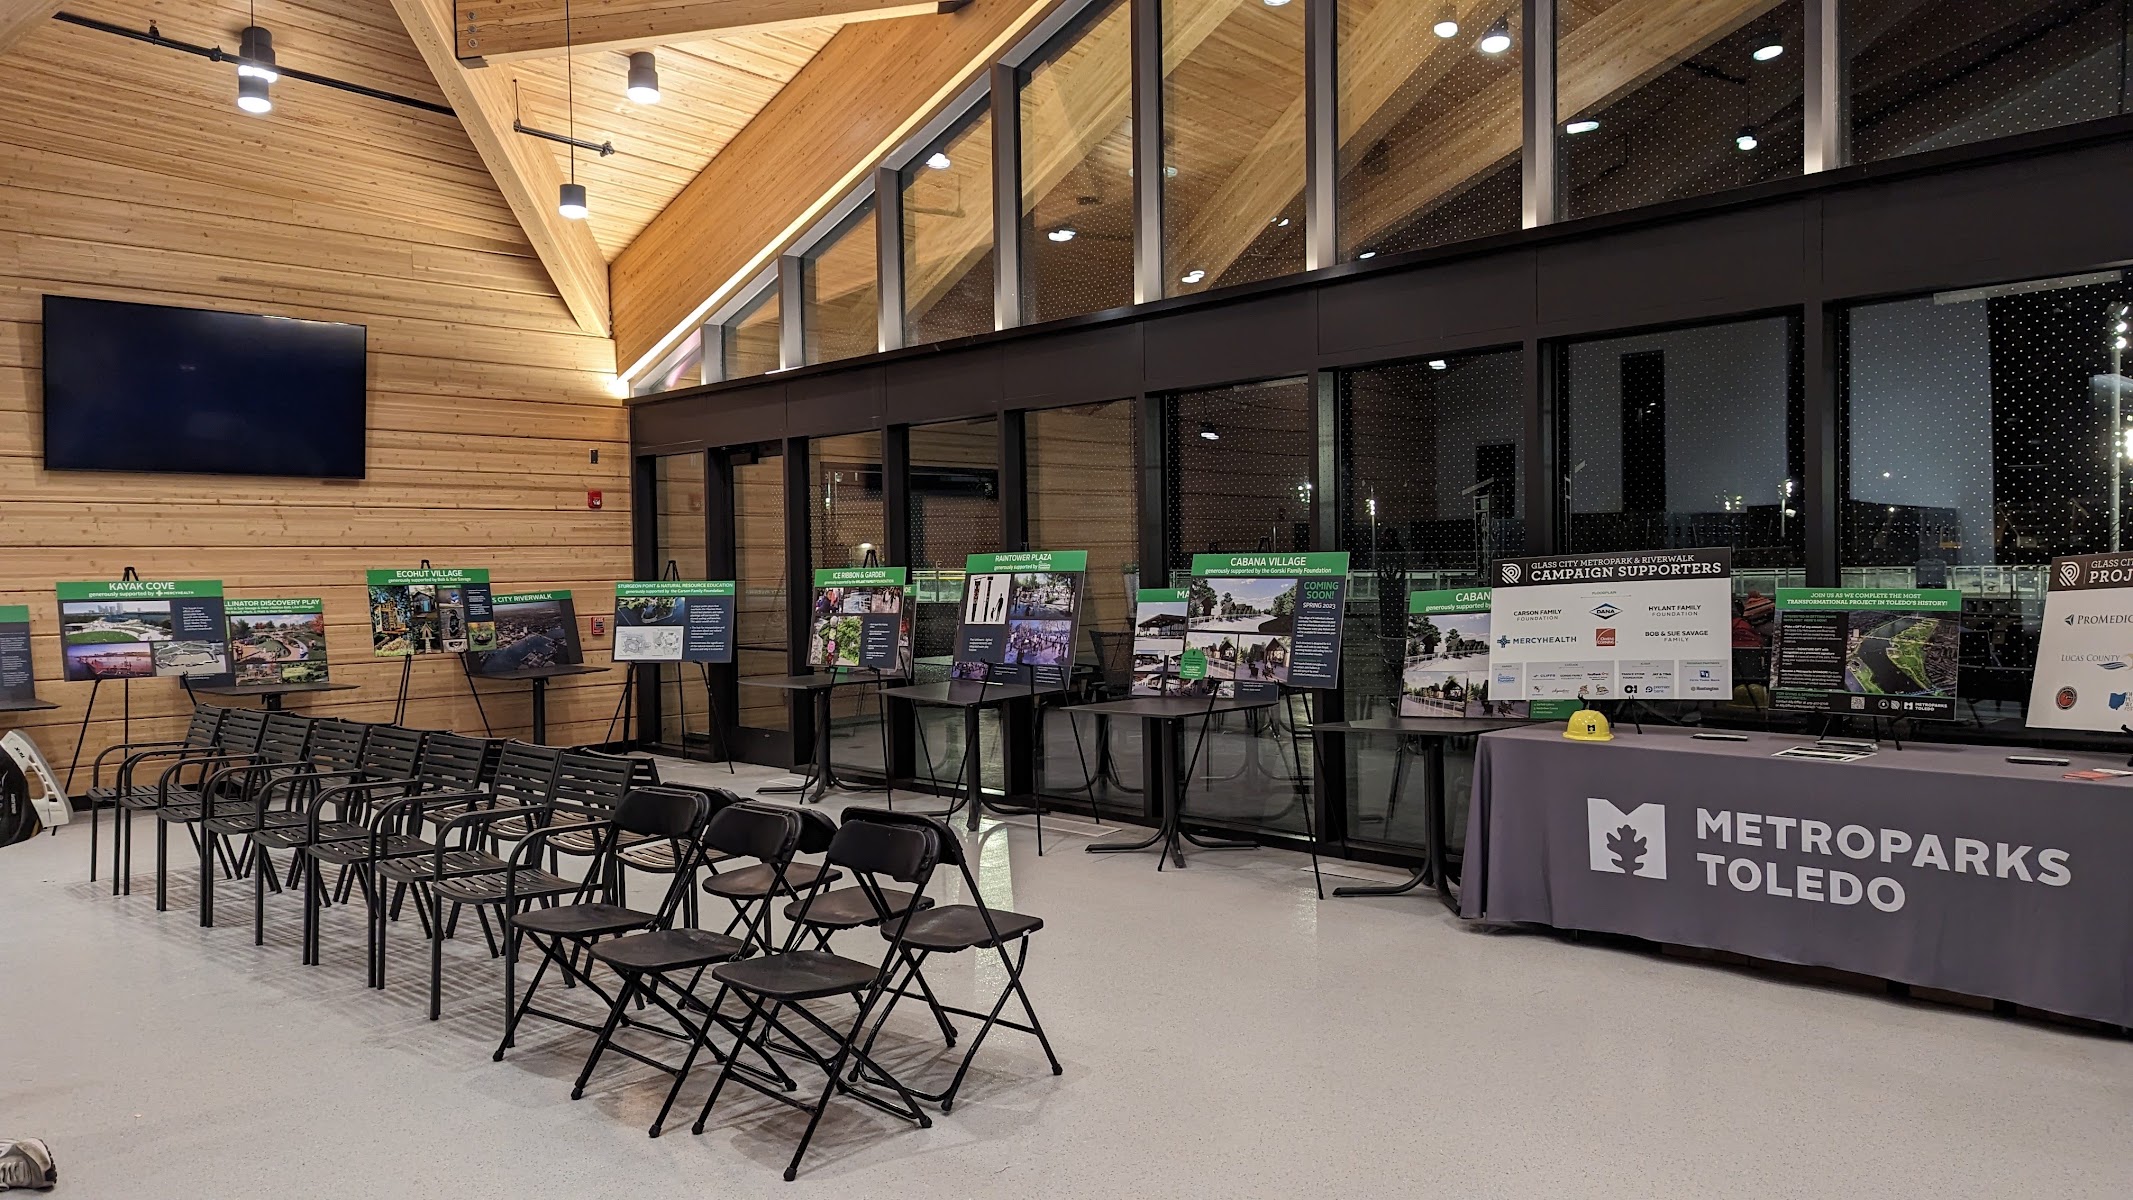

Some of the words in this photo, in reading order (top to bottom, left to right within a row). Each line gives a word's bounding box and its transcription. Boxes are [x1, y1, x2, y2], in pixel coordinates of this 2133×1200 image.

[1230, 558, 1268, 566] CABANA
[1269, 557, 1306, 566] VILLAGE
[1531, 561, 1557, 569] GLASS
[1580, 558, 1632, 567] METROPARK
[1642, 555, 1694, 564] RIVERWALK
[2091, 559, 2118, 568] GLASS
[1531, 566, 1614, 582] CAMPAIGN
[1618, 563, 1722, 576] SUPPORTERS
[2089, 569, 2133, 583] PROJ
[109, 582, 143, 590] KAYAK
[1304, 582, 1339, 590] COMING
[1306, 591, 1335, 599] SOON!
[1696, 808, 2072, 887] METROPARKS
[1696, 852, 1906, 912] TOLEDO
